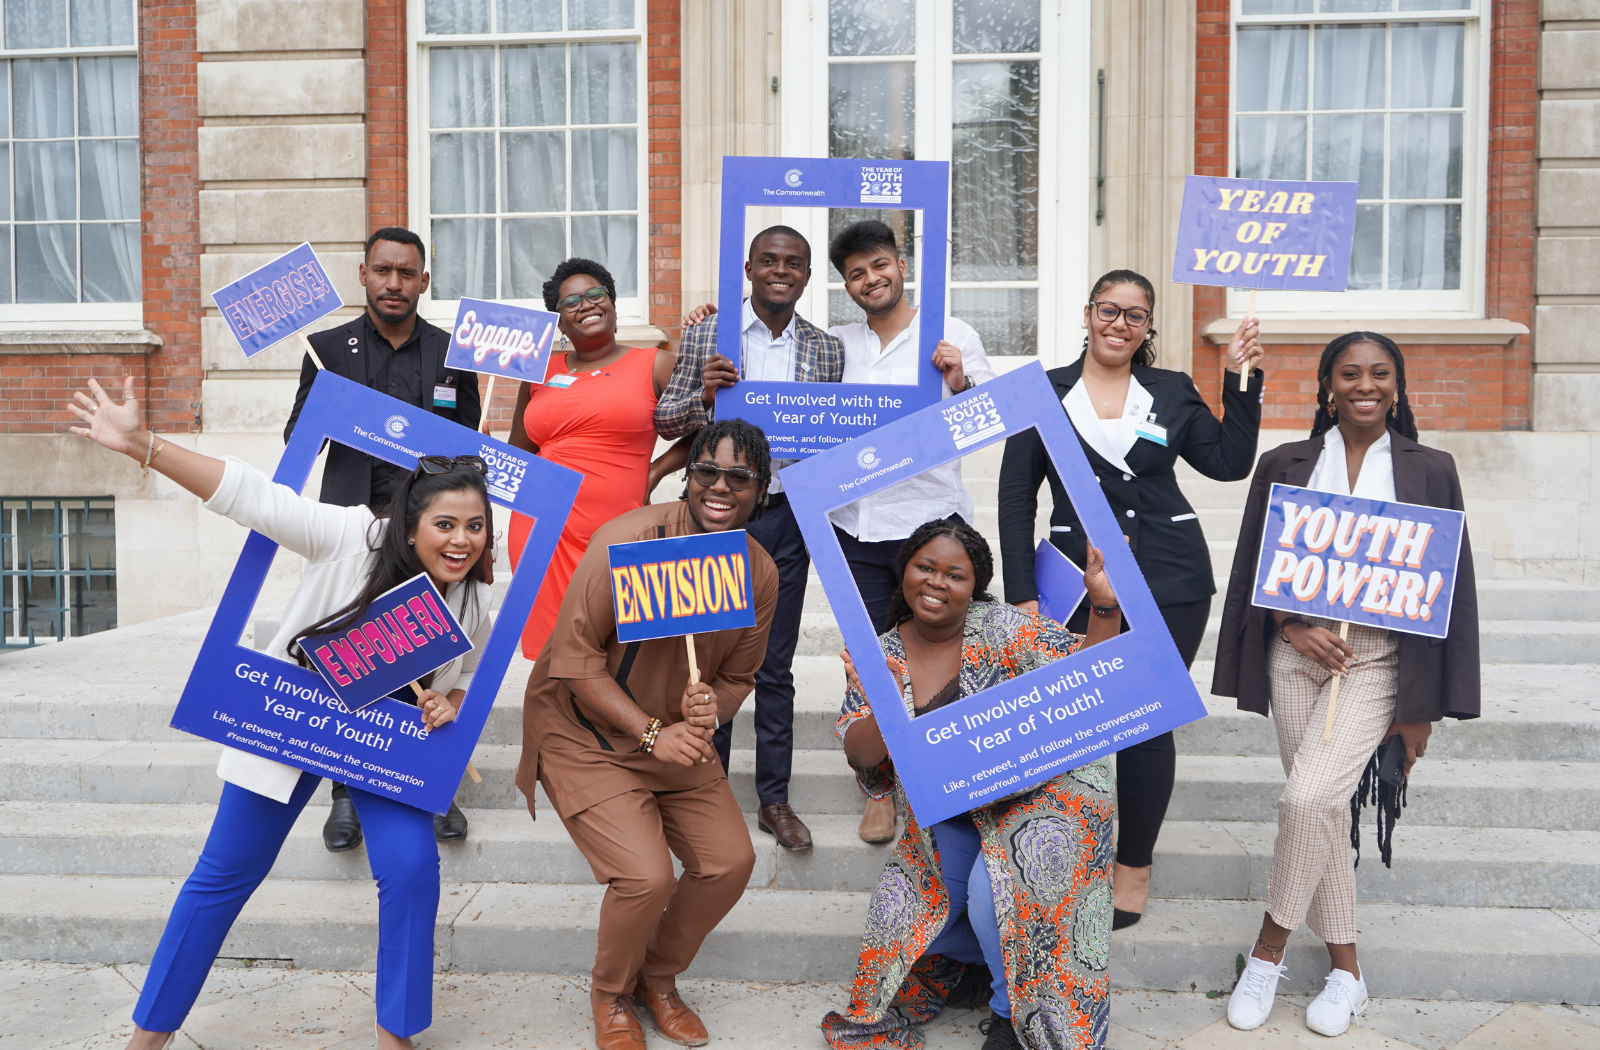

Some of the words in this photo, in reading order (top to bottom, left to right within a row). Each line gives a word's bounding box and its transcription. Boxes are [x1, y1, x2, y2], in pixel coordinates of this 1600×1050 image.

[763, 188, 775, 196] The
[776, 189, 825, 197] Commonwealth
[861, 172, 902, 182] YOUTH
[1218, 188, 1315, 215] YEAR
[1236, 221, 1287, 245] OF
[1192, 248, 1327, 278] YOUTH
[224, 261, 331, 341] ENERGISE!
[456, 310, 553, 367] Engage!
[745, 392, 771, 405] Get
[776, 393, 836, 407] Involved
[841, 394, 873, 408] with
[878, 395, 902, 409] the
[772, 411, 806, 424] Year
[810, 412, 826, 425] of
[830, 412, 877, 426] Youth!
[941, 405, 958, 416] THE
[957, 396, 979, 409] YEAR
[979, 391, 989, 400] OF
[943, 397, 995, 426] YOUTH
[353, 425, 368, 438] The
[801, 435, 816, 443] and
[818, 435, 843, 444] follow
[479, 450, 526, 479] YOUTH
[481, 444, 496, 456] THE
[497, 450, 518, 464] YEAR
[517, 459, 529, 468] OF
[838, 482, 855, 492] The
[854, 457, 914, 486] Commonwealth
[1278, 501, 1435, 569] YOUTH
[612, 553, 747, 624] ENVISION!
[1262, 550, 1443, 622] POWER!
[314, 590, 458, 687] EMPOWER!
[235, 663, 269, 687] Get
[355, 708, 394, 729] with
[399, 719, 429, 741] the
[264, 695, 306, 722] Year
[308, 715, 331, 730] of
[335, 719, 393, 752] Youth!
[925, 721, 962, 745] Get
[963, 686, 1042, 730] Involved
[1044, 669, 1088, 697] with
[1091, 656, 1124, 678] the
[968, 727, 1012, 754] Year
[1018, 713, 1037, 735] of
[1039, 688, 1105, 725] Youth!
[212, 710, 238, 728] Like,
[241, 721, 285, 743] retweet,
[288, 737, 309, 749] and
[309, 742, 342, 760] follow
[343, 754, 361, 767] the
[362, 762, 425, 788] conversation
[225, 731, 279, 754] #YearofYouth
[281, 749, 365, 782] #CommonwealthYouth
[367, 777, 402, 794] #CYP@50
[943, 779, 970, 794] Like,
[971, 759, 1018, 783] retweet,
[1019, 748, 1039, 764] and
[1040, 736, 1073, 755] follow
[1074, 728, 1094, 741] the
[1095, 701, 1162, 733] conversation
[968, 774, 1021, 801] #YearofYouth
[1023, 739, 1111, 779] #CommonwealthYouth
[1113, 722, 1150, 743] #CYP@50
